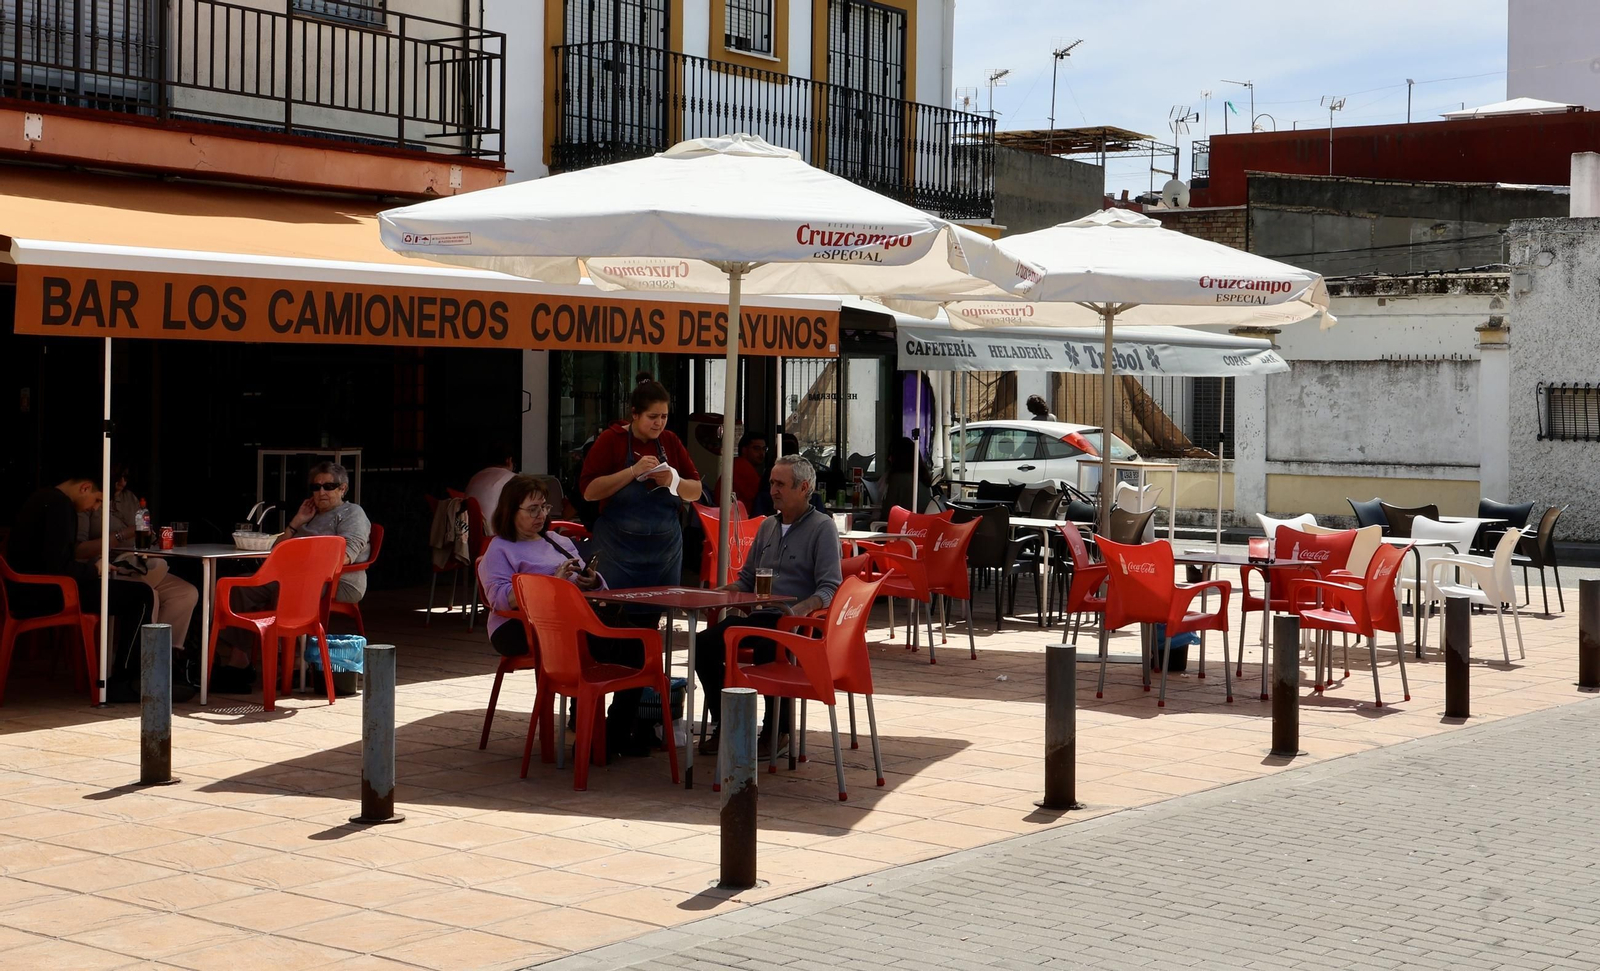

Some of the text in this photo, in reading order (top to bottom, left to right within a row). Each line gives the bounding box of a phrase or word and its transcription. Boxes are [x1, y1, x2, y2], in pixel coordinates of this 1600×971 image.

[796, 223, 913, 249] Cruzcampo
[1199, 275, 1292, 294] Cruzcampo
[41, 276, 139, 329] BAR
[162, 282, 247, 331] LOS
[268, 288, 509, 341] CAMIONEROS
[530, 302, 665, 345] COMIDAS
[1216, 293, 1269, 305] ESPECIAL
[905, 339, 977, 357] CAFETERÍA
[987, 343, 1053, 360] HELADERÍA
[1222, 355, 1252, 366] COPAS
